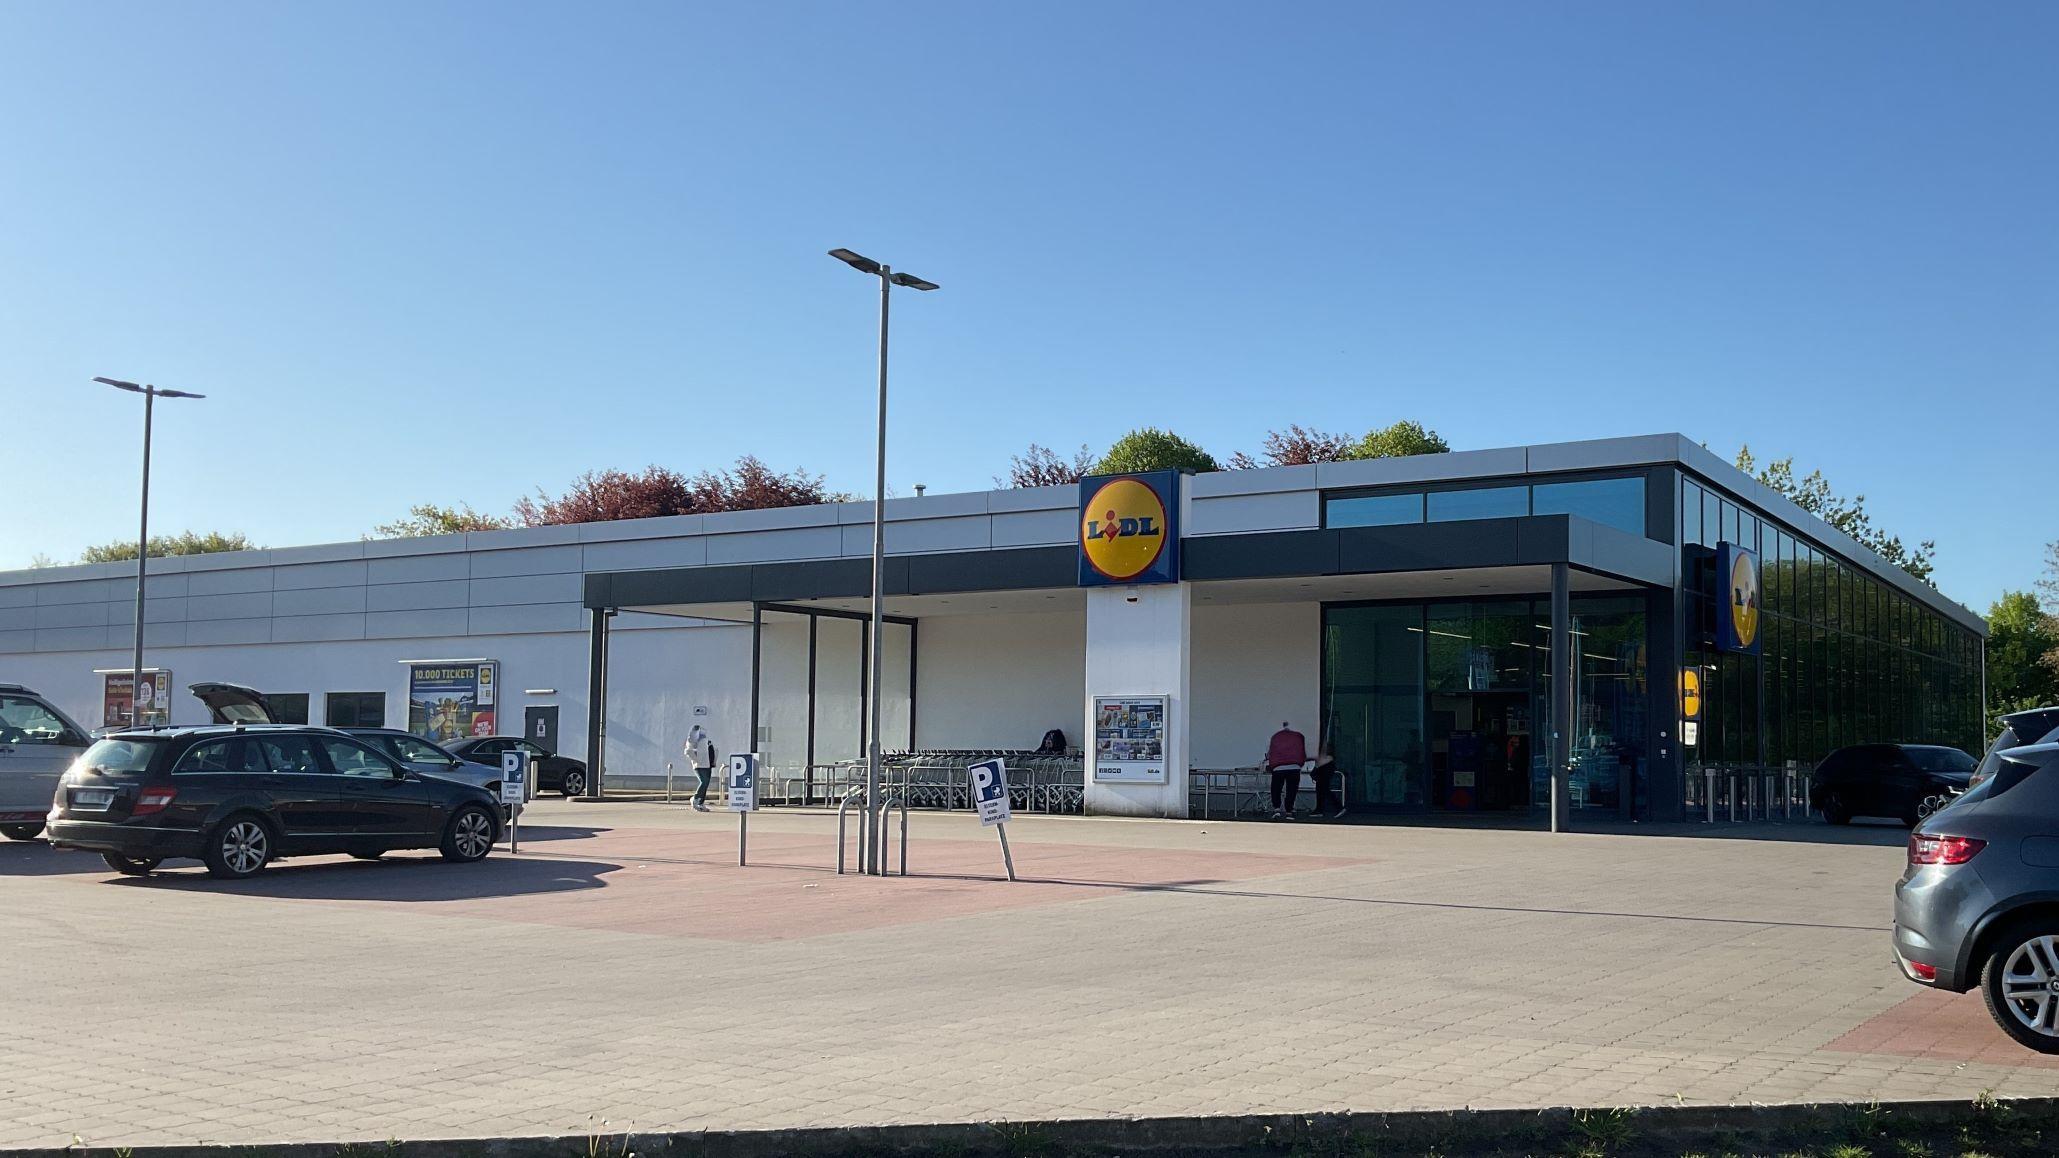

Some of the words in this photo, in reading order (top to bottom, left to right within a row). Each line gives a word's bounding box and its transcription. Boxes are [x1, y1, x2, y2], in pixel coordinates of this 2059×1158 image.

[415, 669, 440, 680] 10.000
[442, 668, 474, 679] TICKETS
[504, 753, 519, 781] P
[731, 756, 747, 787] P
[971, 766, 993, 801] P
